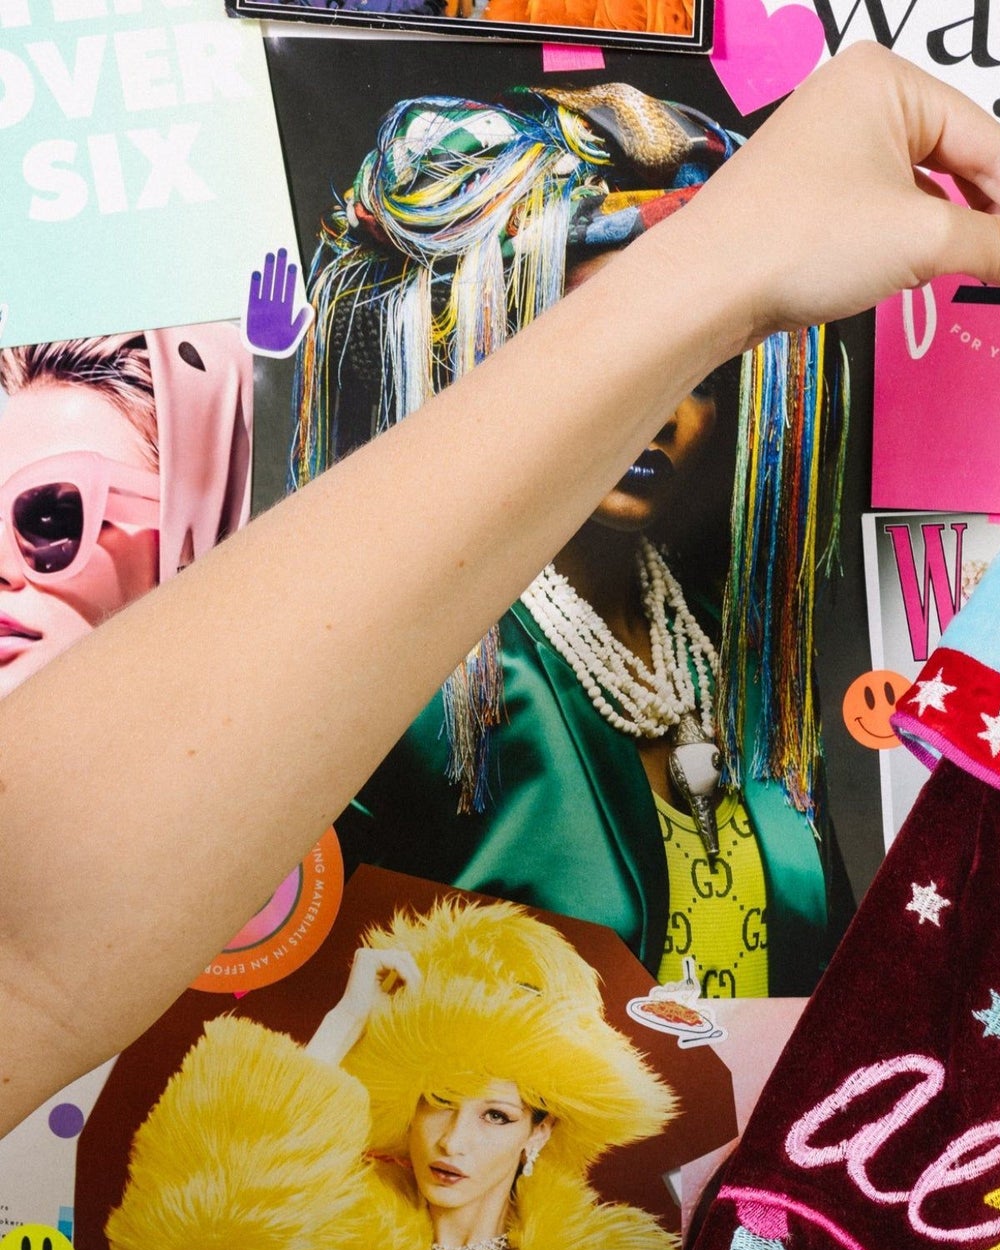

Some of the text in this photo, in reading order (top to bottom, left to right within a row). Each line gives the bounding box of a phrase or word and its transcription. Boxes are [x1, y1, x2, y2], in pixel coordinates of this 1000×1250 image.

[23, 122, 218, 221] SIX
[950, 323, 981, 351] FOR
[884, 522, 968, 662] W
[289, 879, 325, 946] MATERIALS
[250, 956, 269, 970] AN
[273, 945, 289, 960] IN
